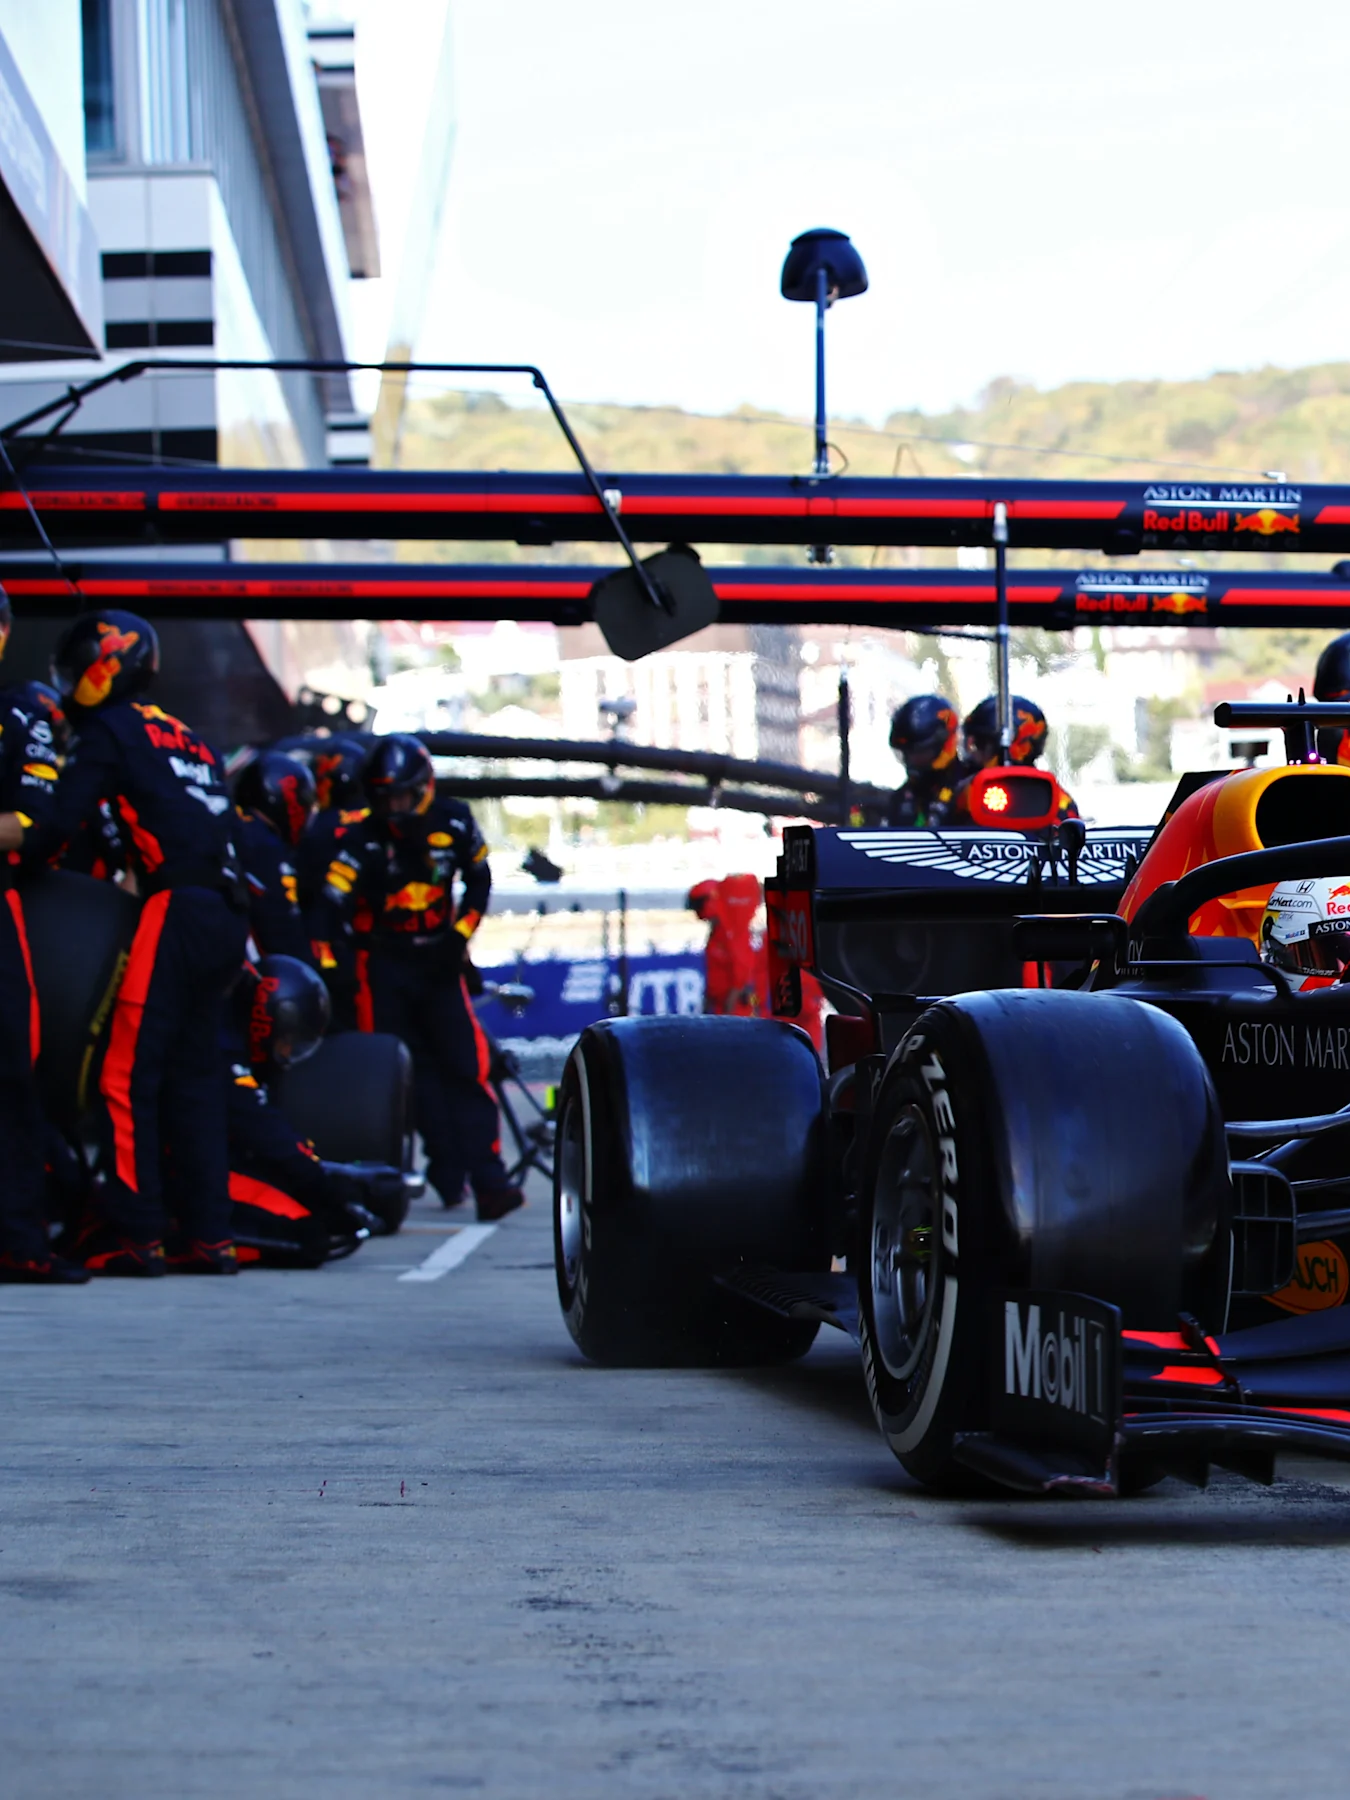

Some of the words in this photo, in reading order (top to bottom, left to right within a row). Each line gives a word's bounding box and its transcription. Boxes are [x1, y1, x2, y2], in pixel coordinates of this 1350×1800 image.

[1143, 485, 1212, 500] ASTON
[1219, 486, 1302, 502] MARTIN
[1075, 573, 1134, 585] ASTON
[1138, 574, 1210, 586] MARTIN
[968, 843, 1038, 861] ASTON
[1221, 1022, 1295, 1066] ASTON
[920, 1052, 959, 1259] ZERO
[1005, 1301, 1086, 1415] Mobil
